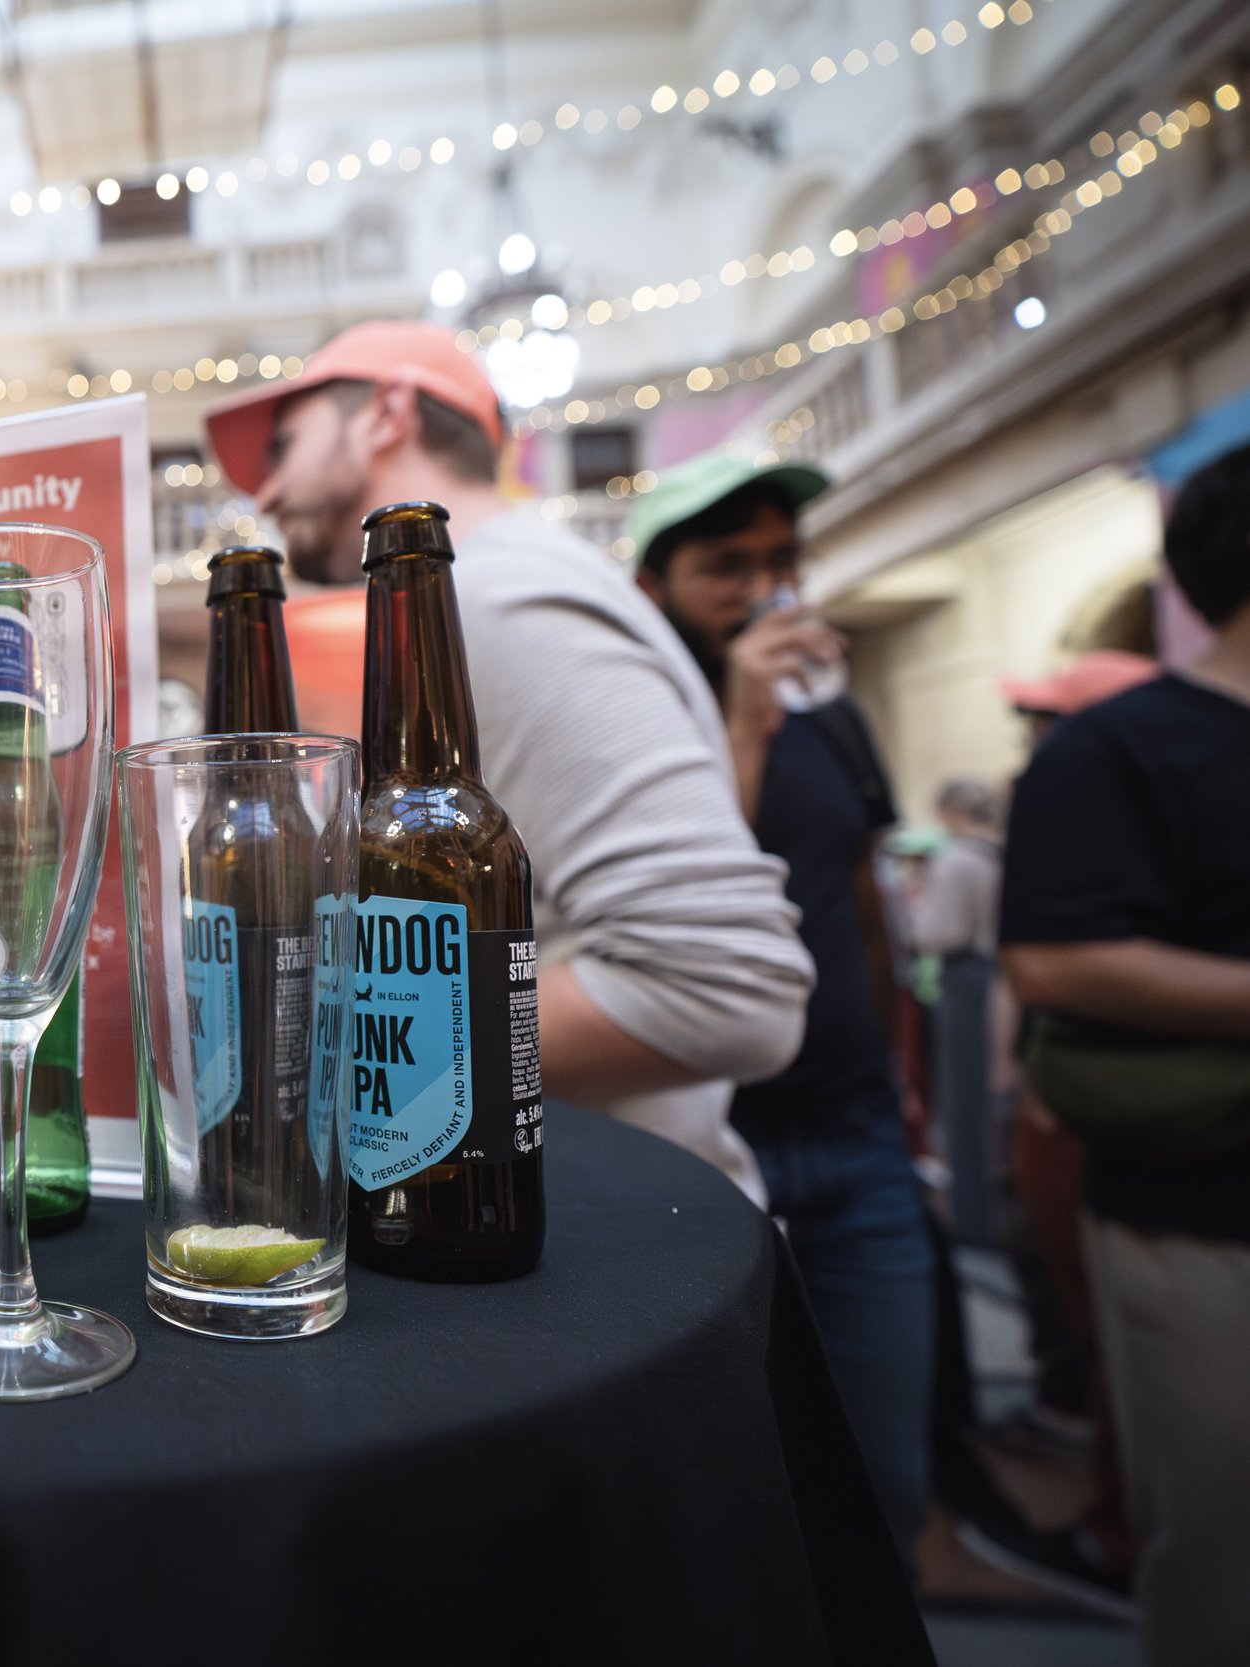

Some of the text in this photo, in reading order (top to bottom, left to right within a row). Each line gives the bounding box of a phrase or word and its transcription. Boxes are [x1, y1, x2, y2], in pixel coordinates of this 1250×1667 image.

[276, 938, 301, 954] THE
[356, 914, 462, 976] WDOG
[509, 942, 528, 961] THE
[377, 992, 419, 1001] IN ELLON
[451, 981, 465, 1075] INDEPENDENT
[352, 1064, 393, 1117] PA
[454, 1080, 465, 1108] AND
[515, 1108, 529, 1126] alc.
[360, 1126, 409, 1142] MODERN
[422, 1111, 464, 1158] DEFIANT
[350, 1136, 389, 1152] CLASSIC
[462, 1150, 484, 1158] 5.4%
[371, 1153, 422, 1182] FIERCELY
